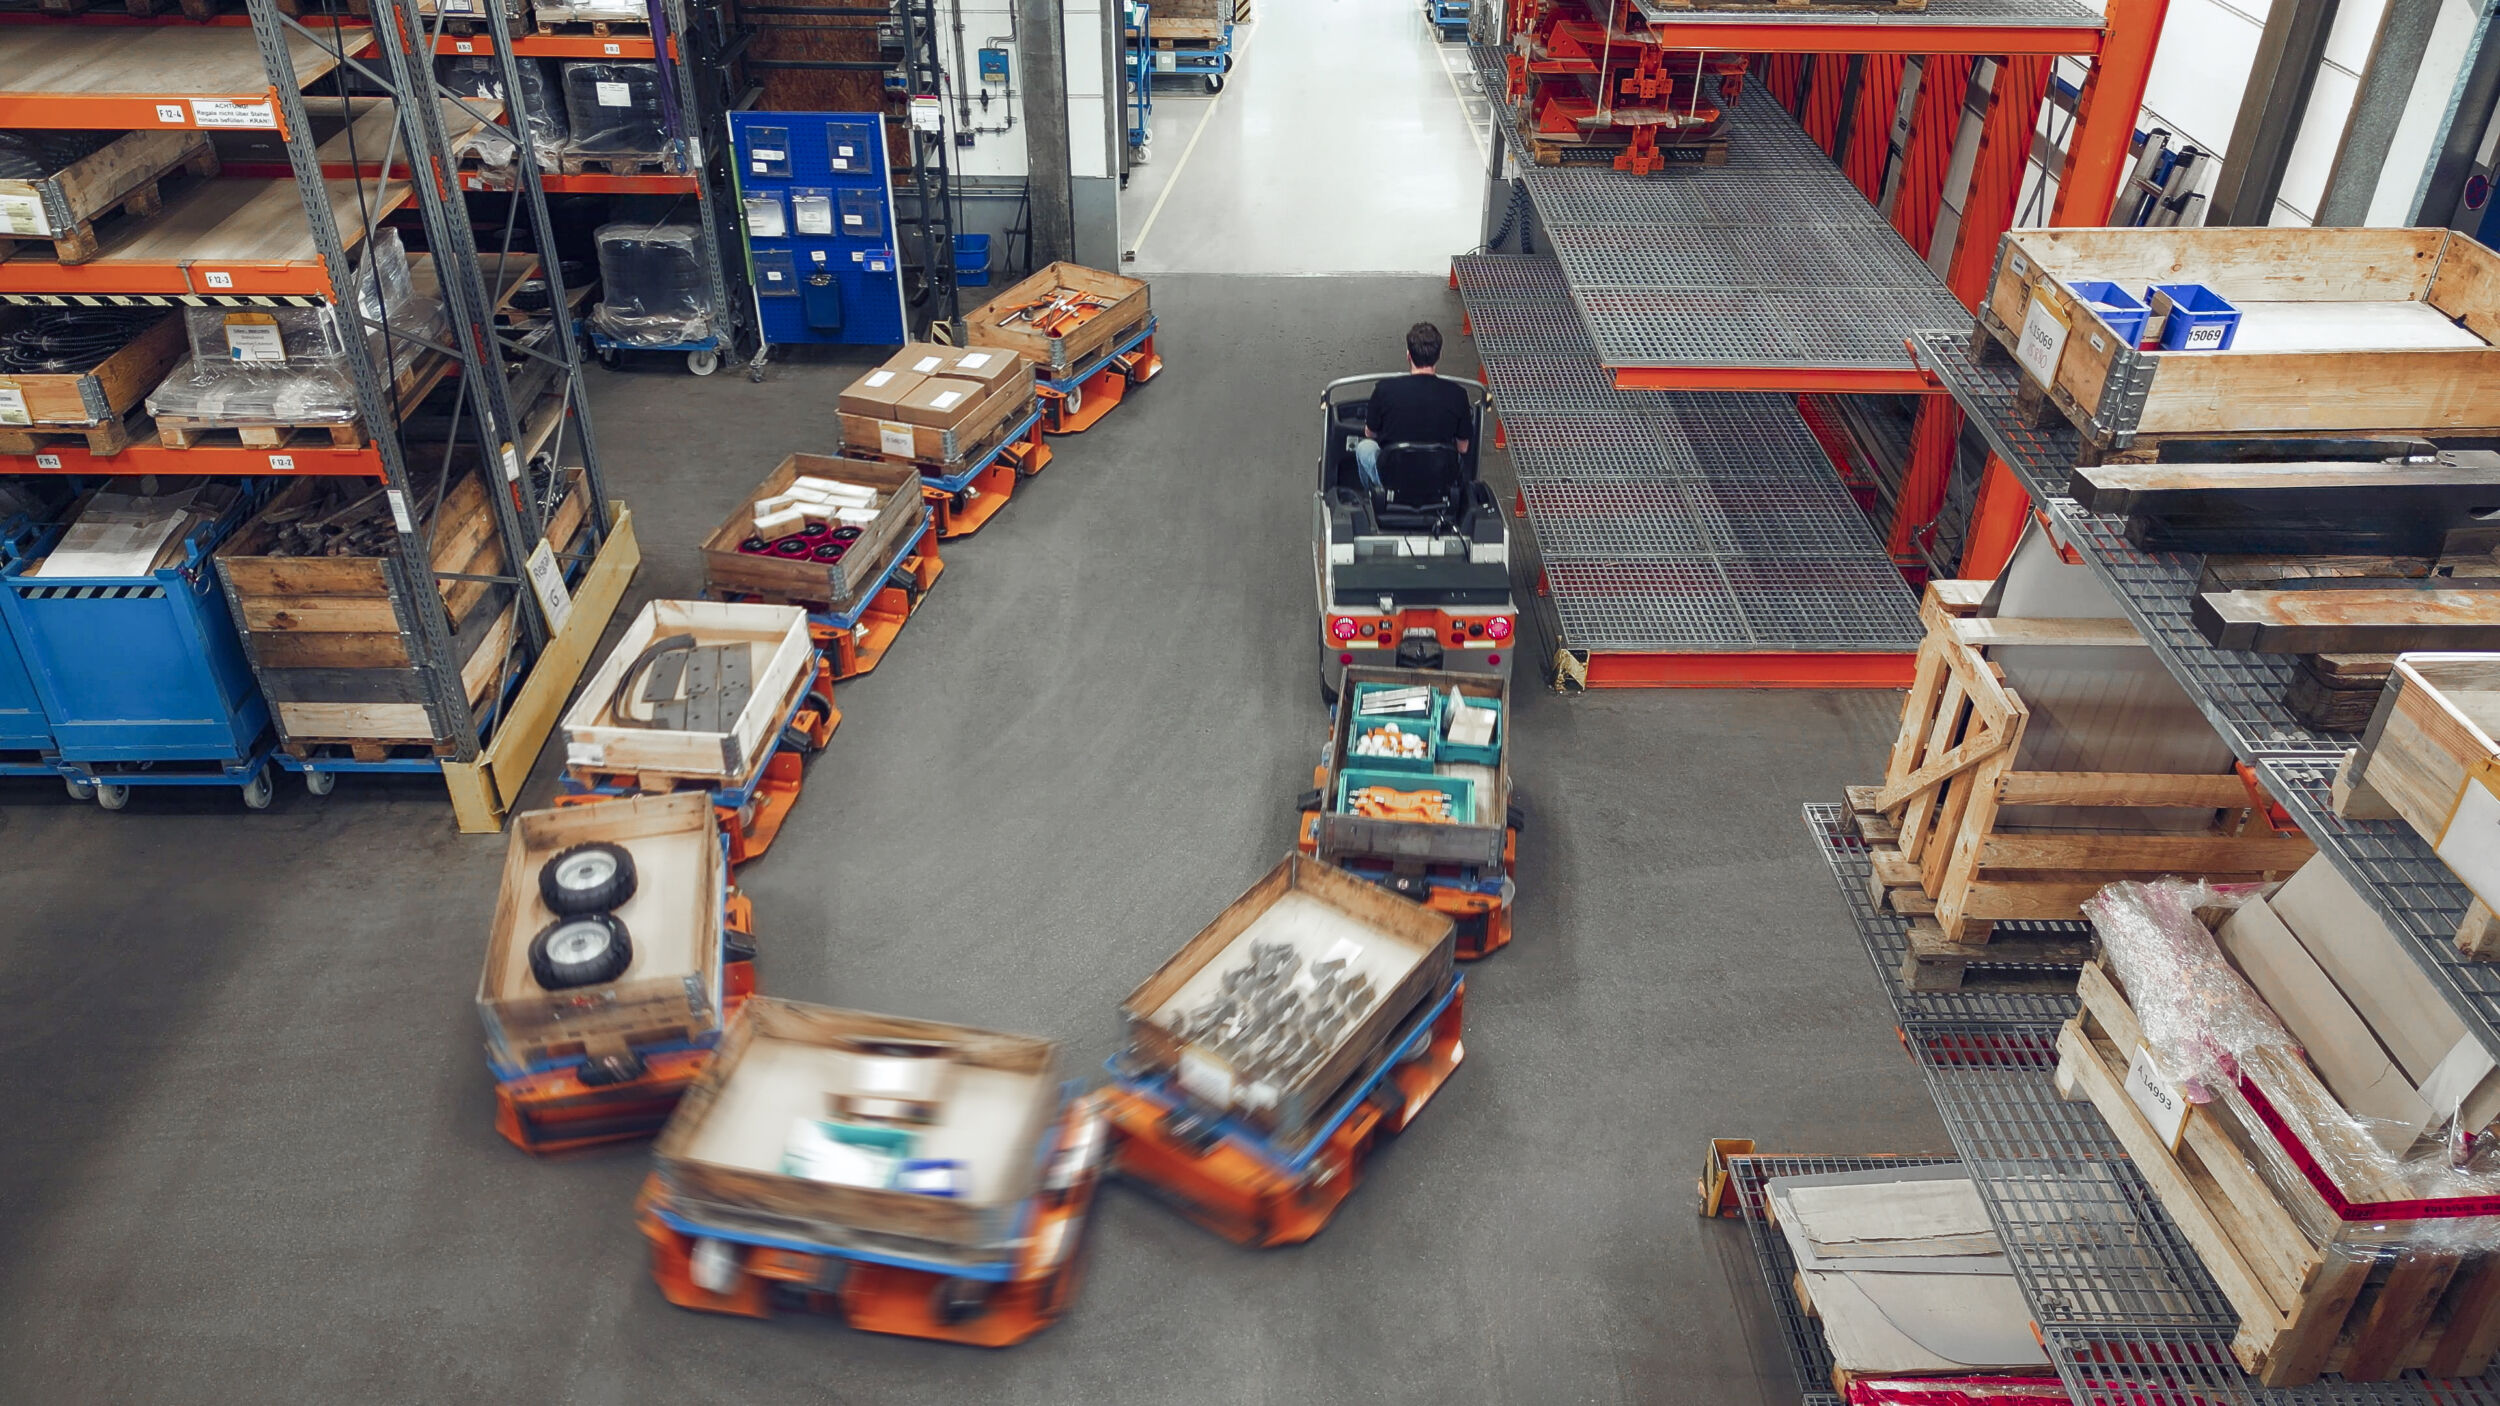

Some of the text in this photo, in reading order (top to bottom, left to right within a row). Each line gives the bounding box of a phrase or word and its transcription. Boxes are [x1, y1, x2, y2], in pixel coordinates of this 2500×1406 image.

[166, 110, 182, 118] 12-4
[2188, 329, 2222, 342] 15069
[550, 588, 560, 608] G
